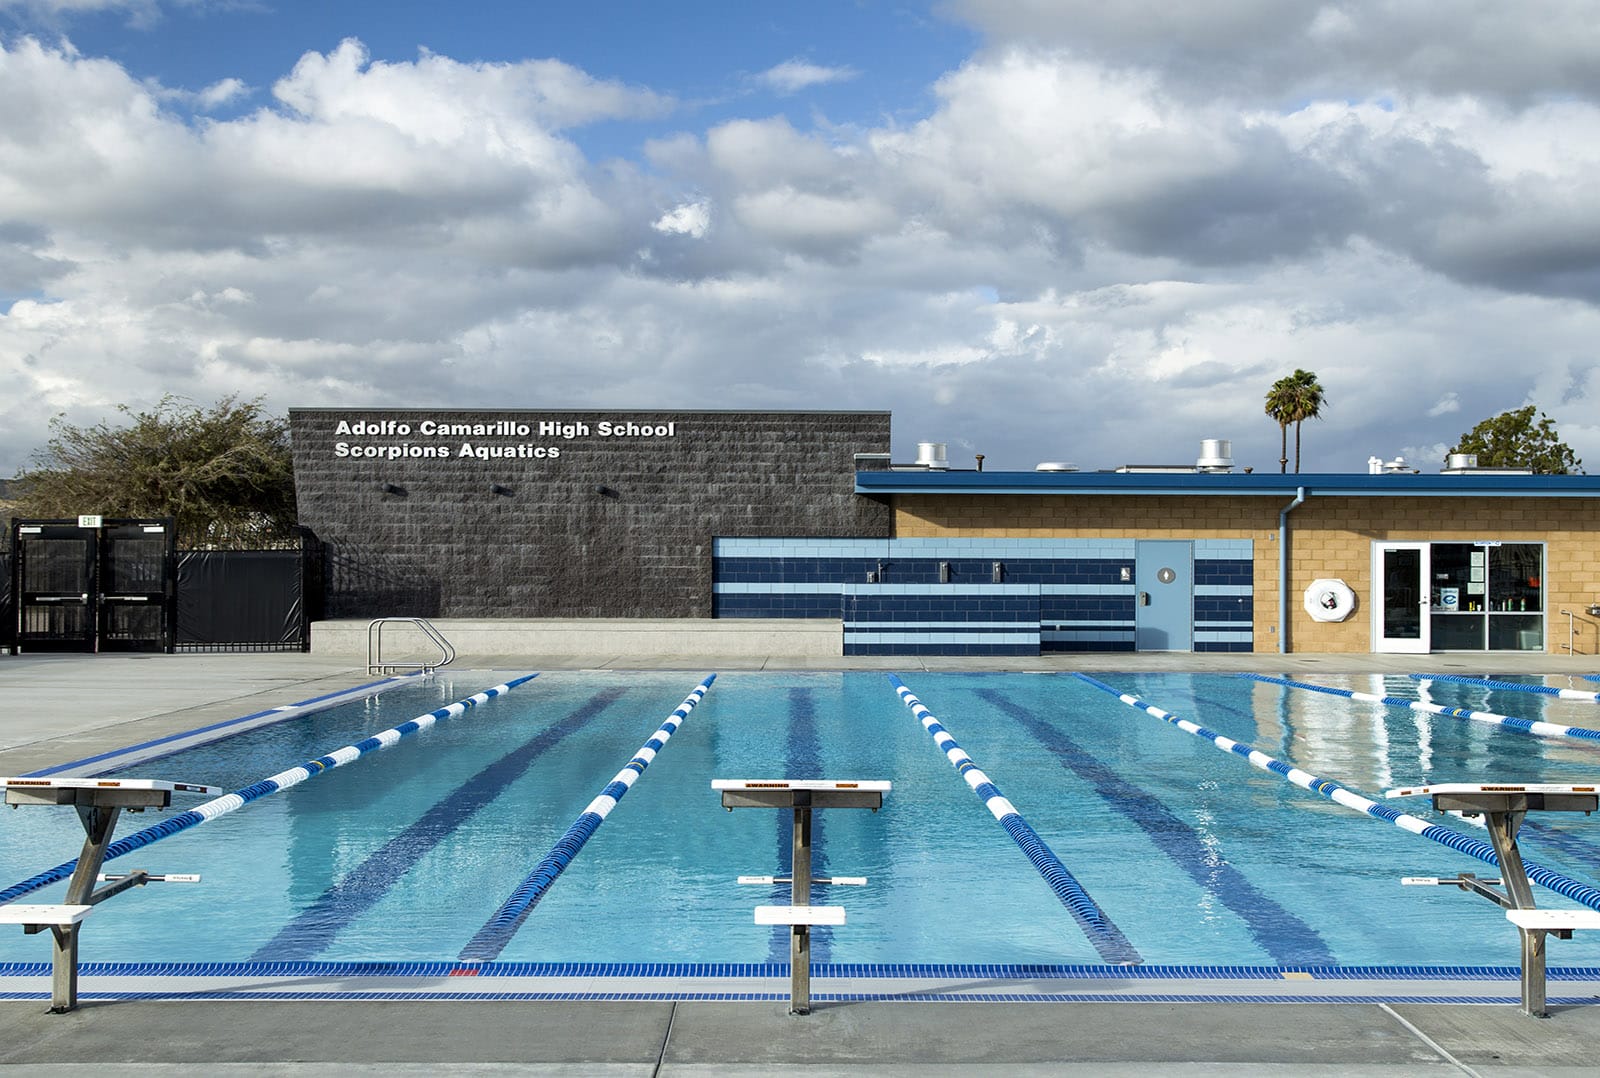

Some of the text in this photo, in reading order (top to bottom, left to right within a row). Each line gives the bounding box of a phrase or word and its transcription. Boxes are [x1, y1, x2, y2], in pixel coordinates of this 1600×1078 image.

[334, 420, 675, 439] Adolfo Camarillo High School
[334, 442, 560, 460] Scorpions Aquatics
[83, 516, 97, 526] EXIT
